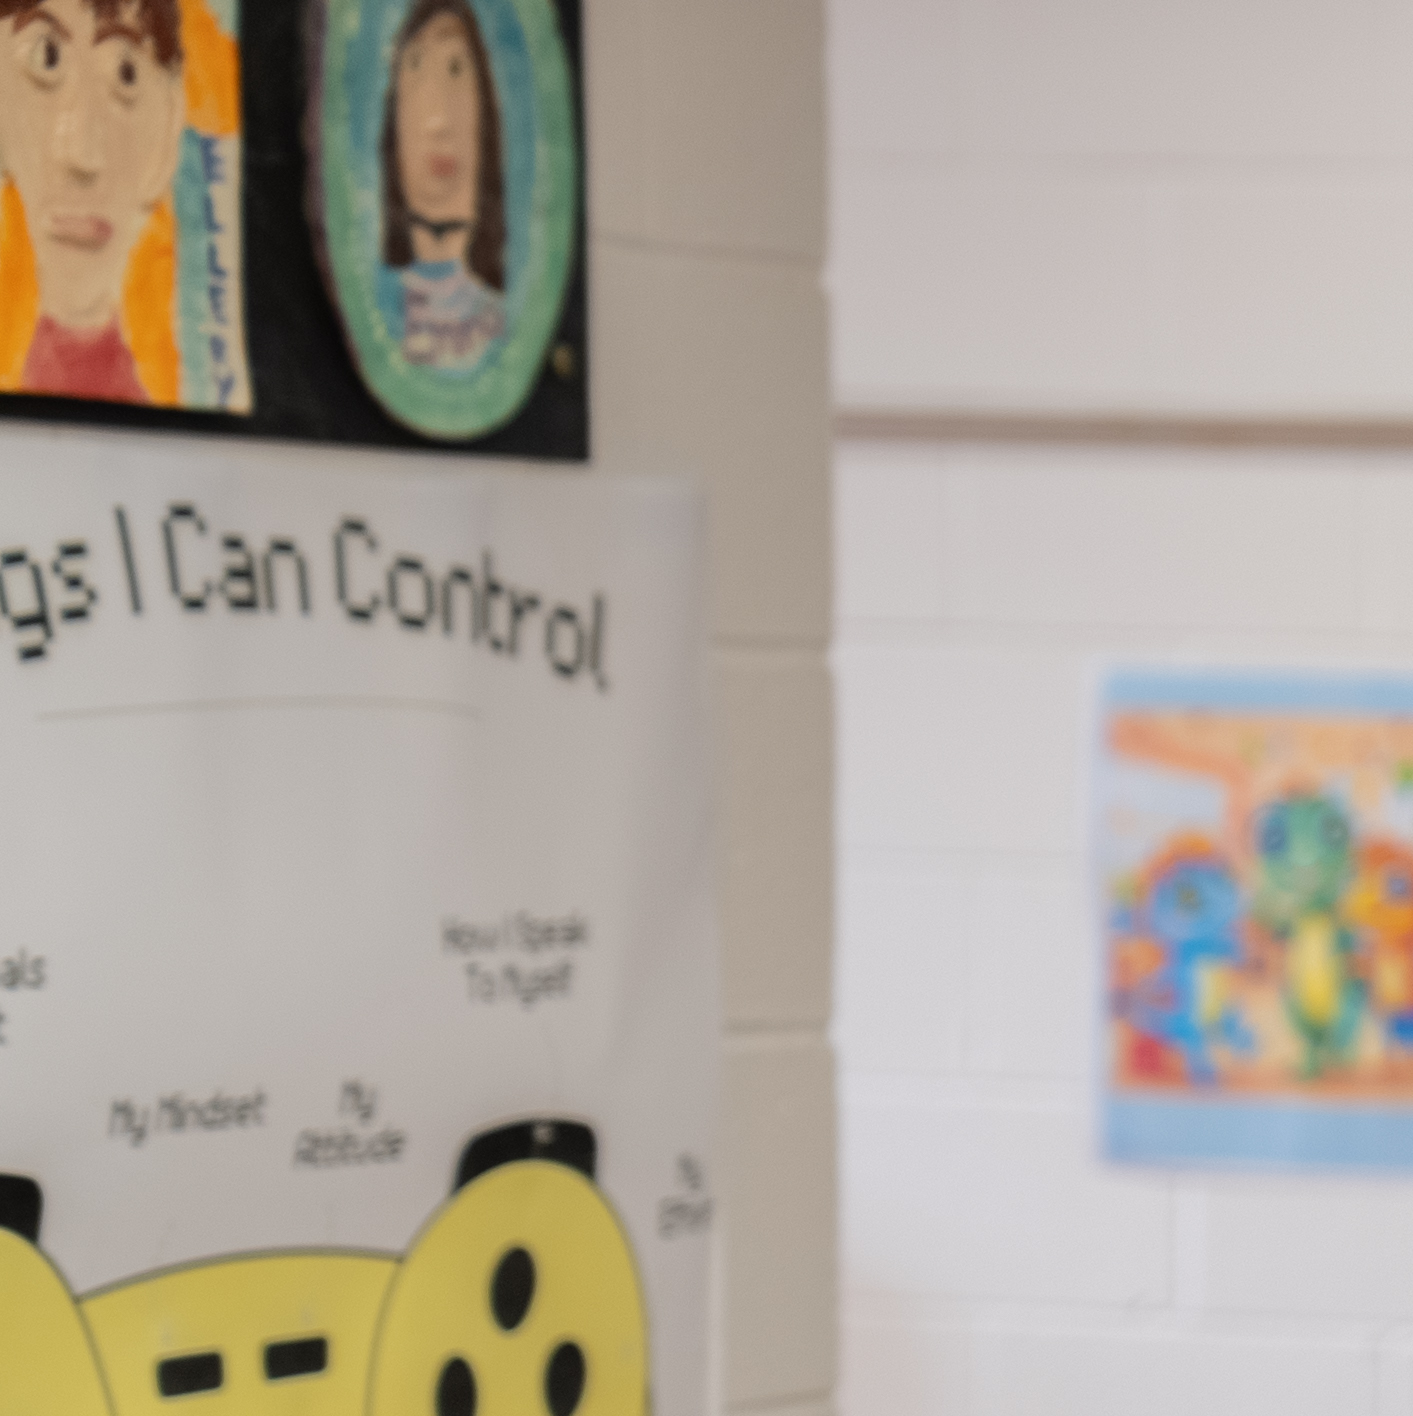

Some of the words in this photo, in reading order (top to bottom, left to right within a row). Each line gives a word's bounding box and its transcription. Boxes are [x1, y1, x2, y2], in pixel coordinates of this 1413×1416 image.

[113, 503, 142, 615] I
[161, 502, 310, 616] Can
[335, 518, 609, 694] Control
[107, 1095, 150, 1149] My
[155, 1087, 267, 1134] Mindset
